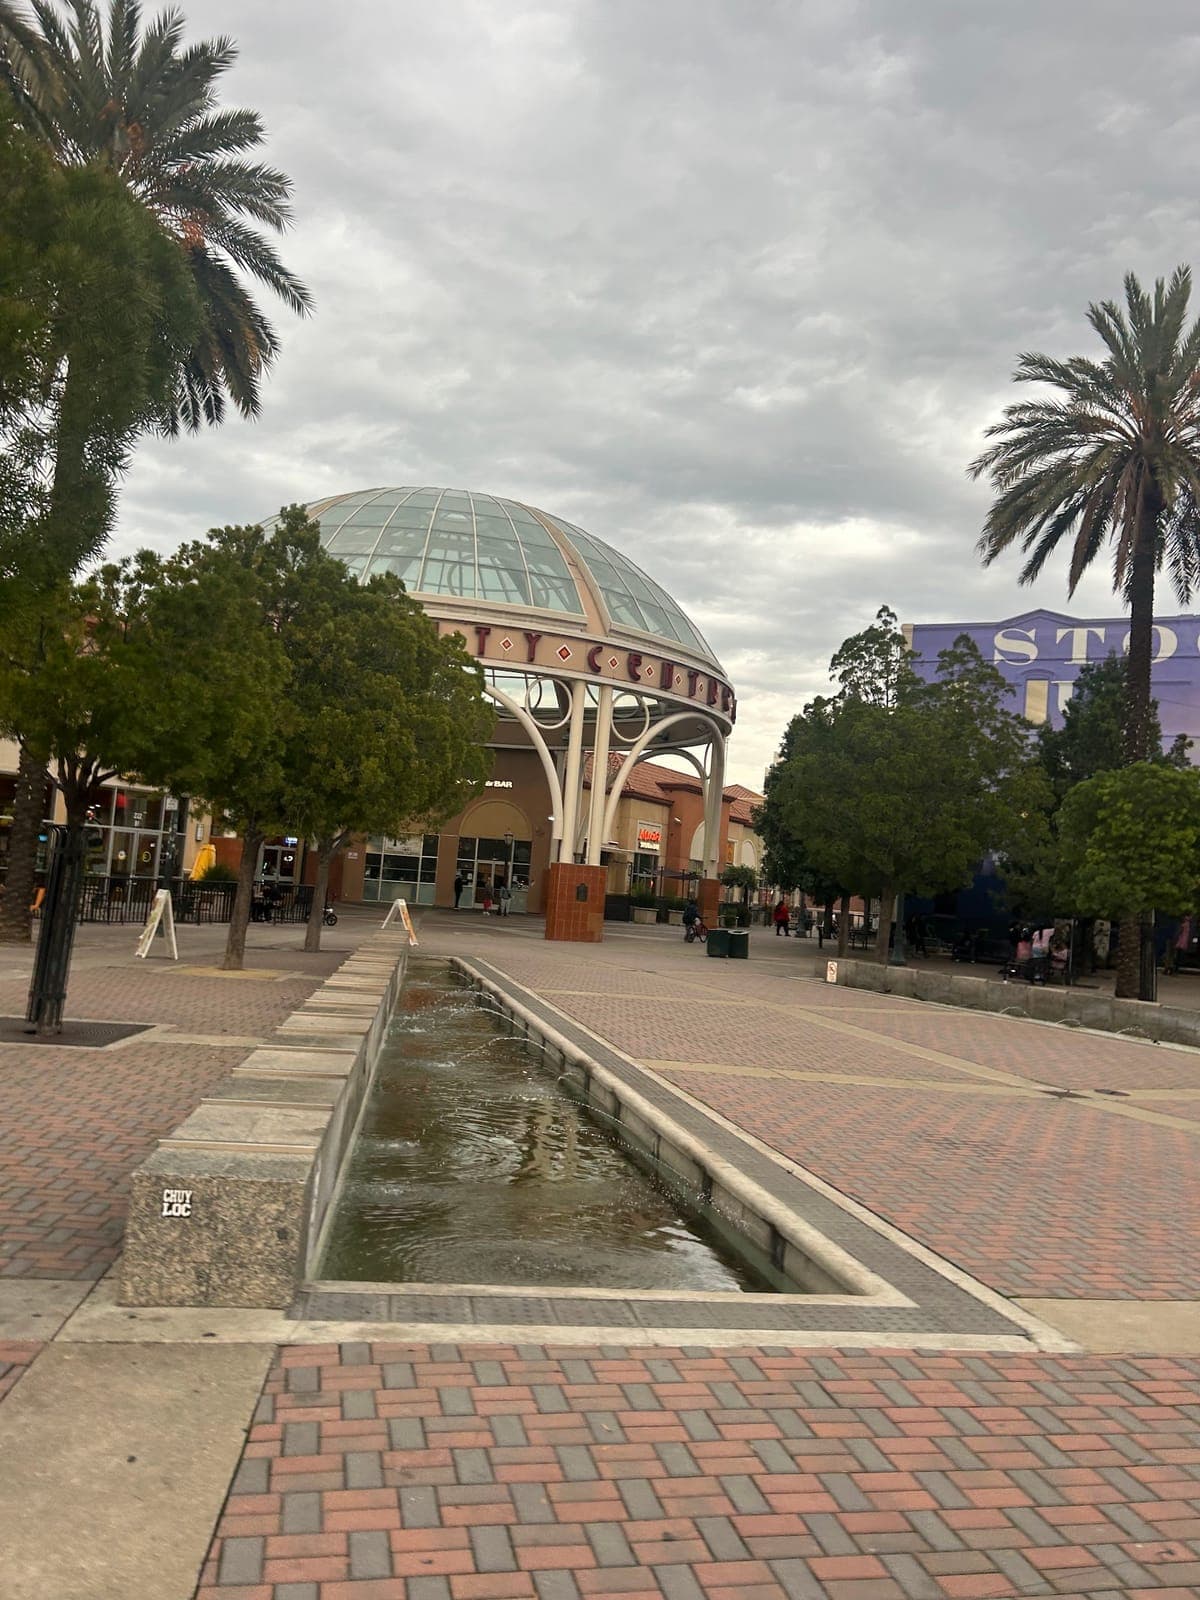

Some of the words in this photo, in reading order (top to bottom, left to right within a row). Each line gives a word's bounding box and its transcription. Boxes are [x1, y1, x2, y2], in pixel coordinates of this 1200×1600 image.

[993, 625, 1200, 666] STO
[494, 780, 513, 789] BAR
[163, 1188, 193, 1204] CHUY
[162, 1202, 192, 1217] LOC
